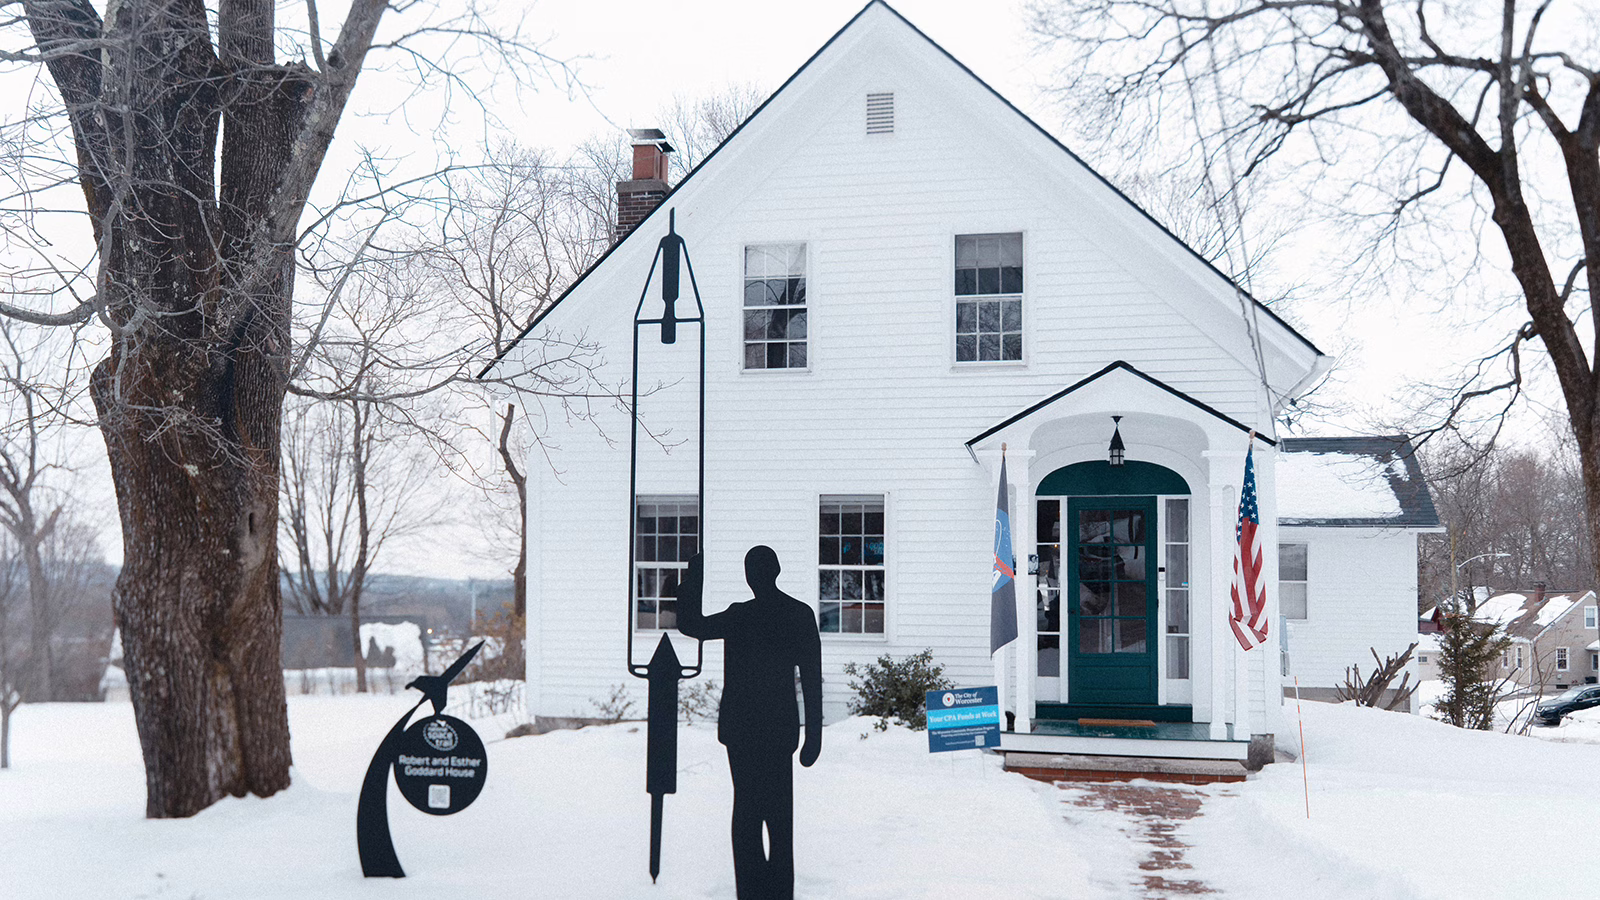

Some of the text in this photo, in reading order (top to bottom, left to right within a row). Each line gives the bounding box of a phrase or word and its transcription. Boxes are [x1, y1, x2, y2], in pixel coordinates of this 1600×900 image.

[944, 714, 957, 722] CPA
[958, 712, 974, 720] Funds
[399, 755, 481, 766] Robert and Esther
[404, 765, 475, 777] Goddard House
